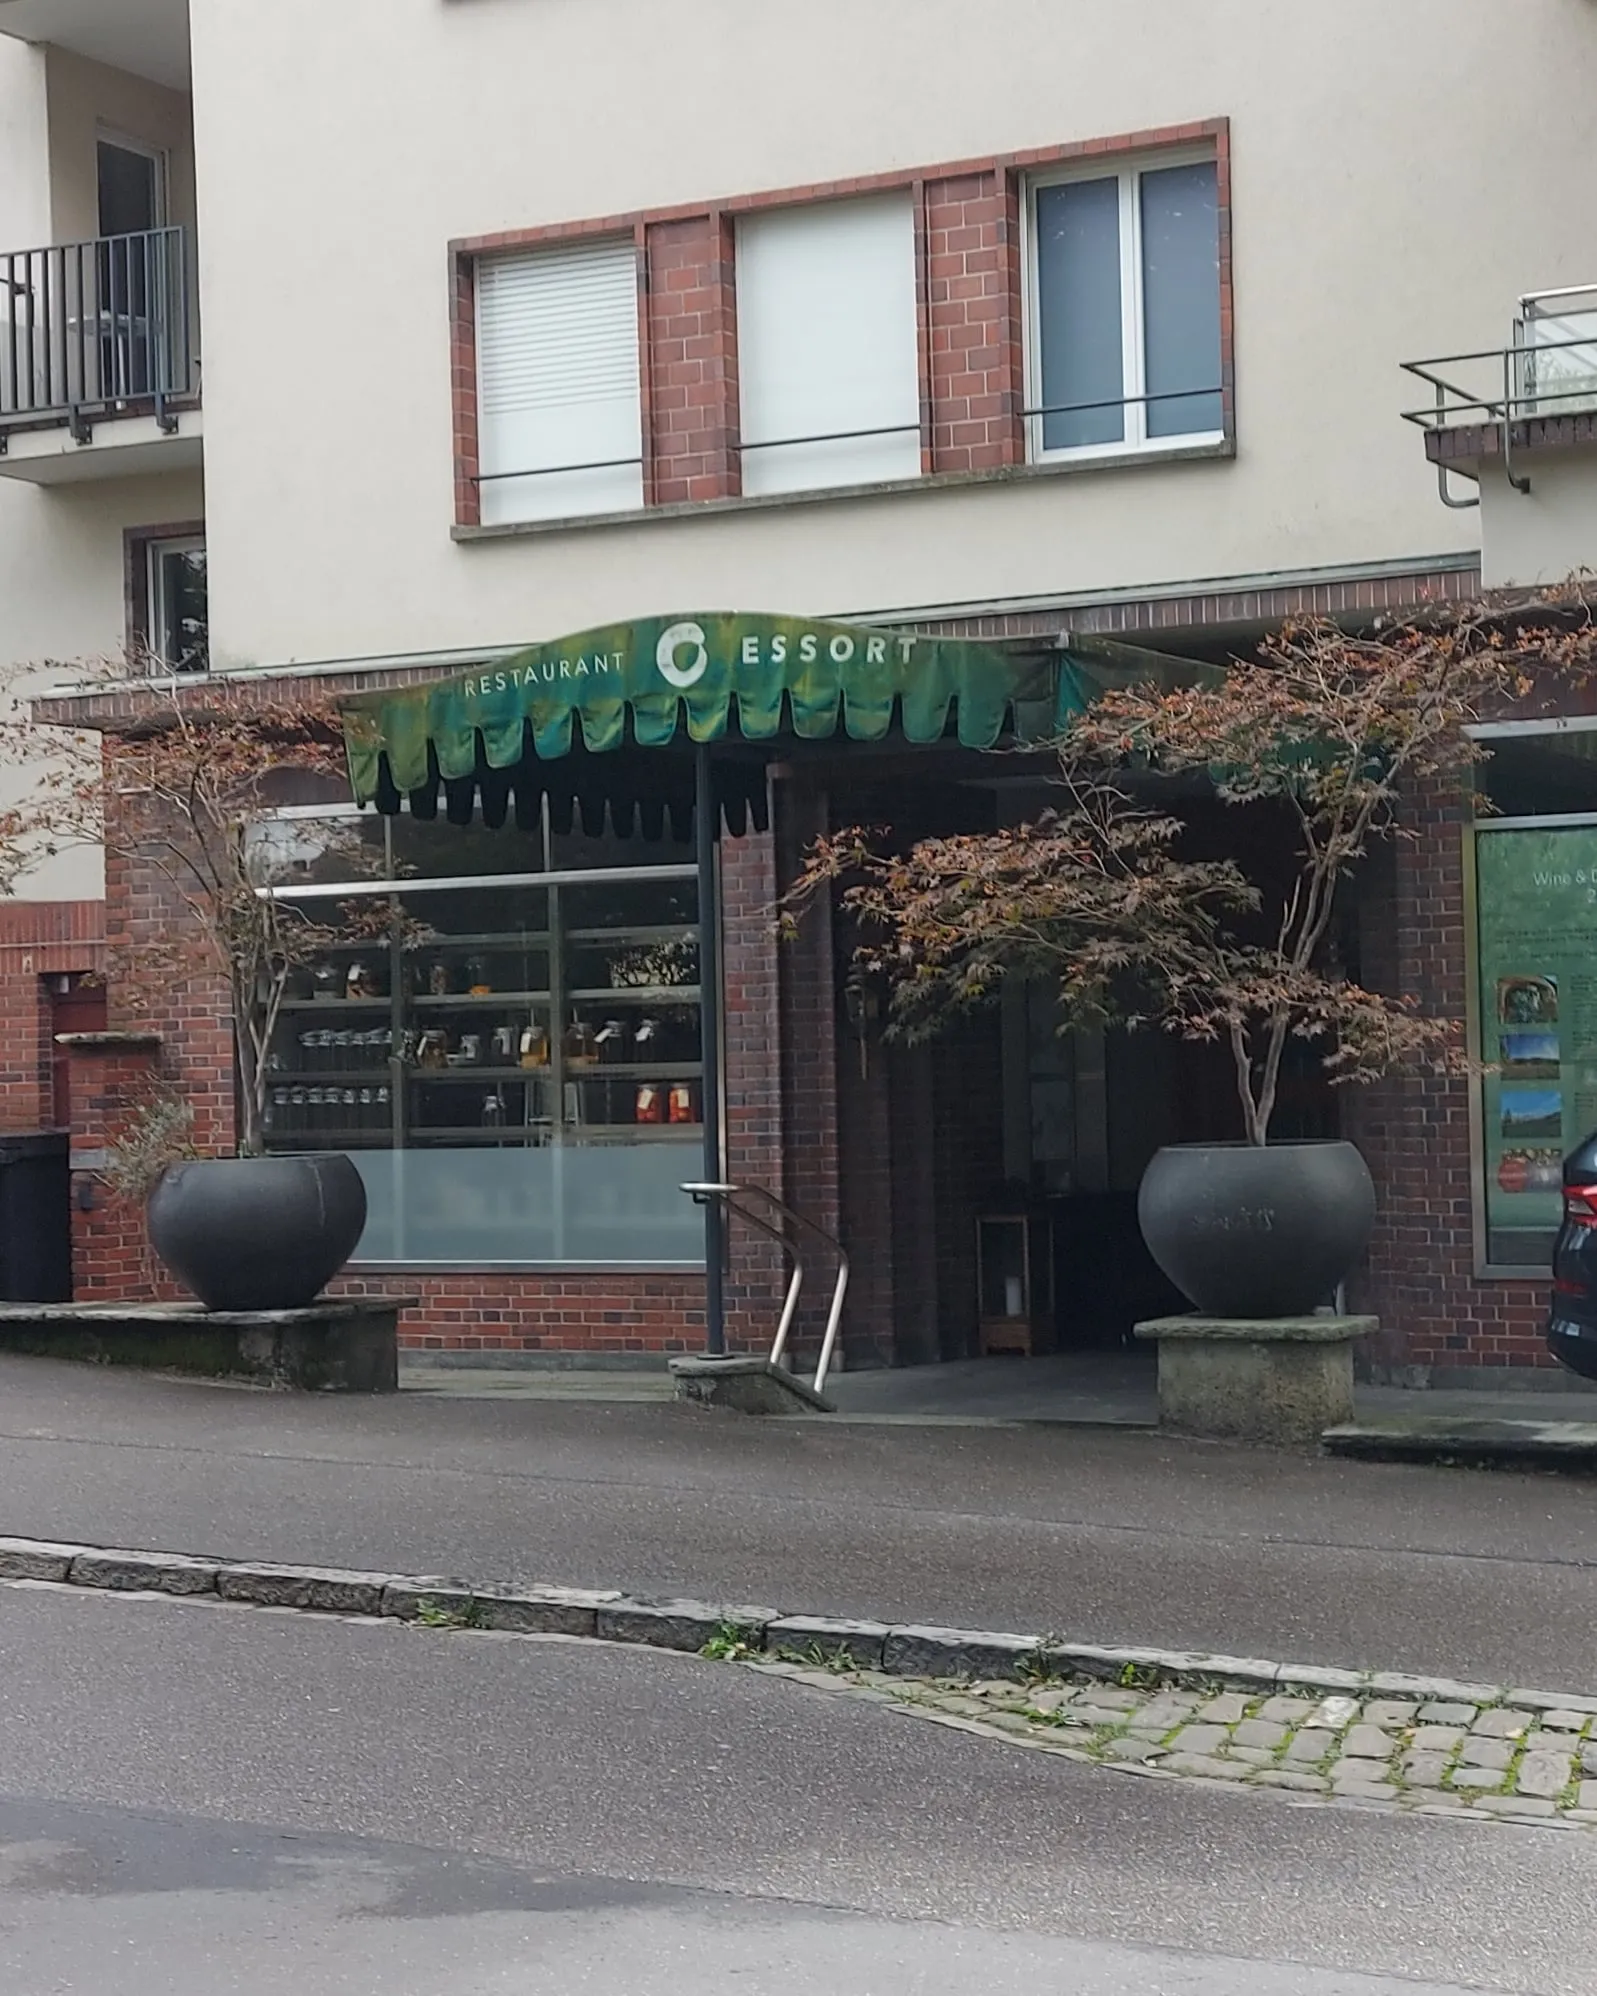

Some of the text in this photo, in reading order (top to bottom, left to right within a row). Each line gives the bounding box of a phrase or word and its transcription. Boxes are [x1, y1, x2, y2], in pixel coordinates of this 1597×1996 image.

[463, 651, 624, 698] RESTAURANT
[741, 633, 917, 665] ESSORT
[1533, 871, 1572, 887] Wine
[1575, 868, 1586, 885] &
